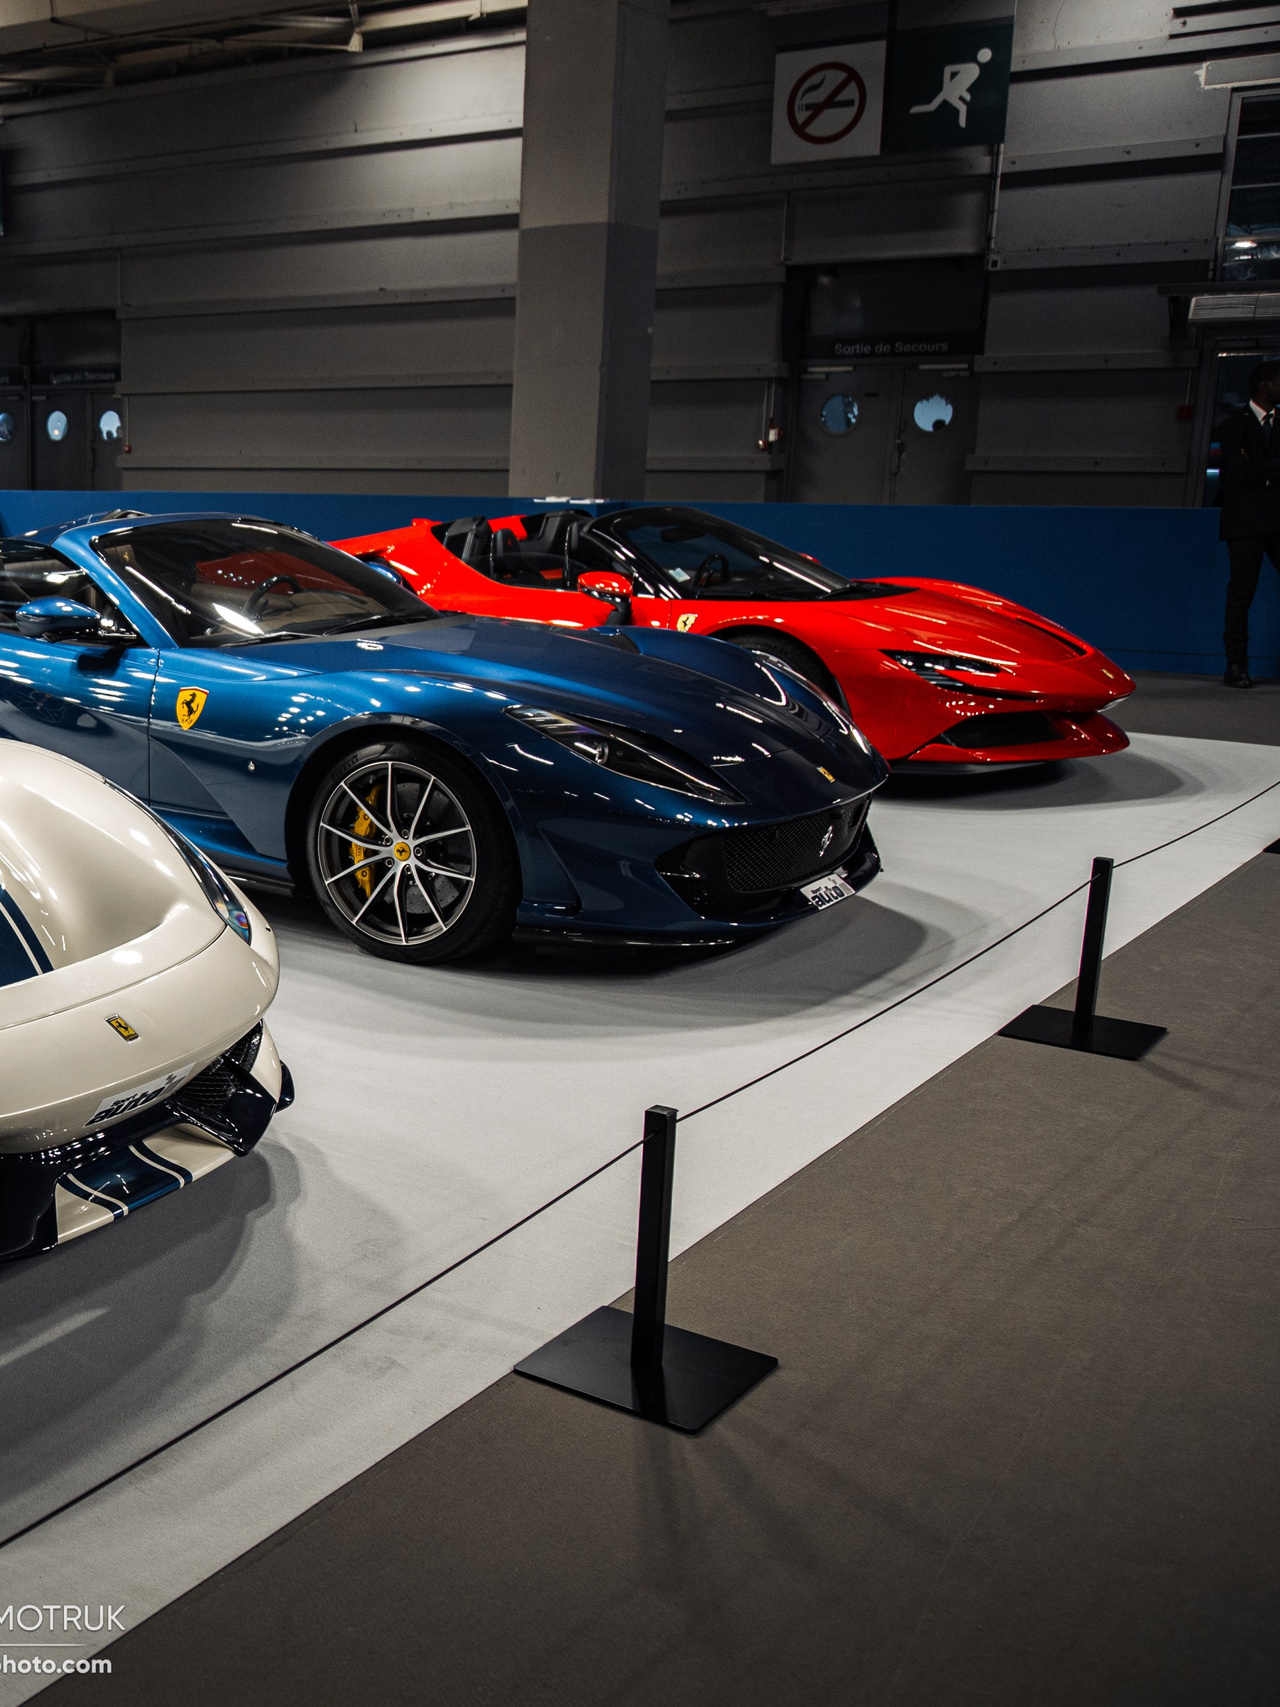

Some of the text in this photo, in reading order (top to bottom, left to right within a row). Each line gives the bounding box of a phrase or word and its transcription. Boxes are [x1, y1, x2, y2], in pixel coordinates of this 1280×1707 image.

[834, 341, 948, 355] Sortie de Secours
[84, 371, 116, 381] Secours
[811, 886, 846, 908] auto
[85, 1086, 166, 1127] auto
